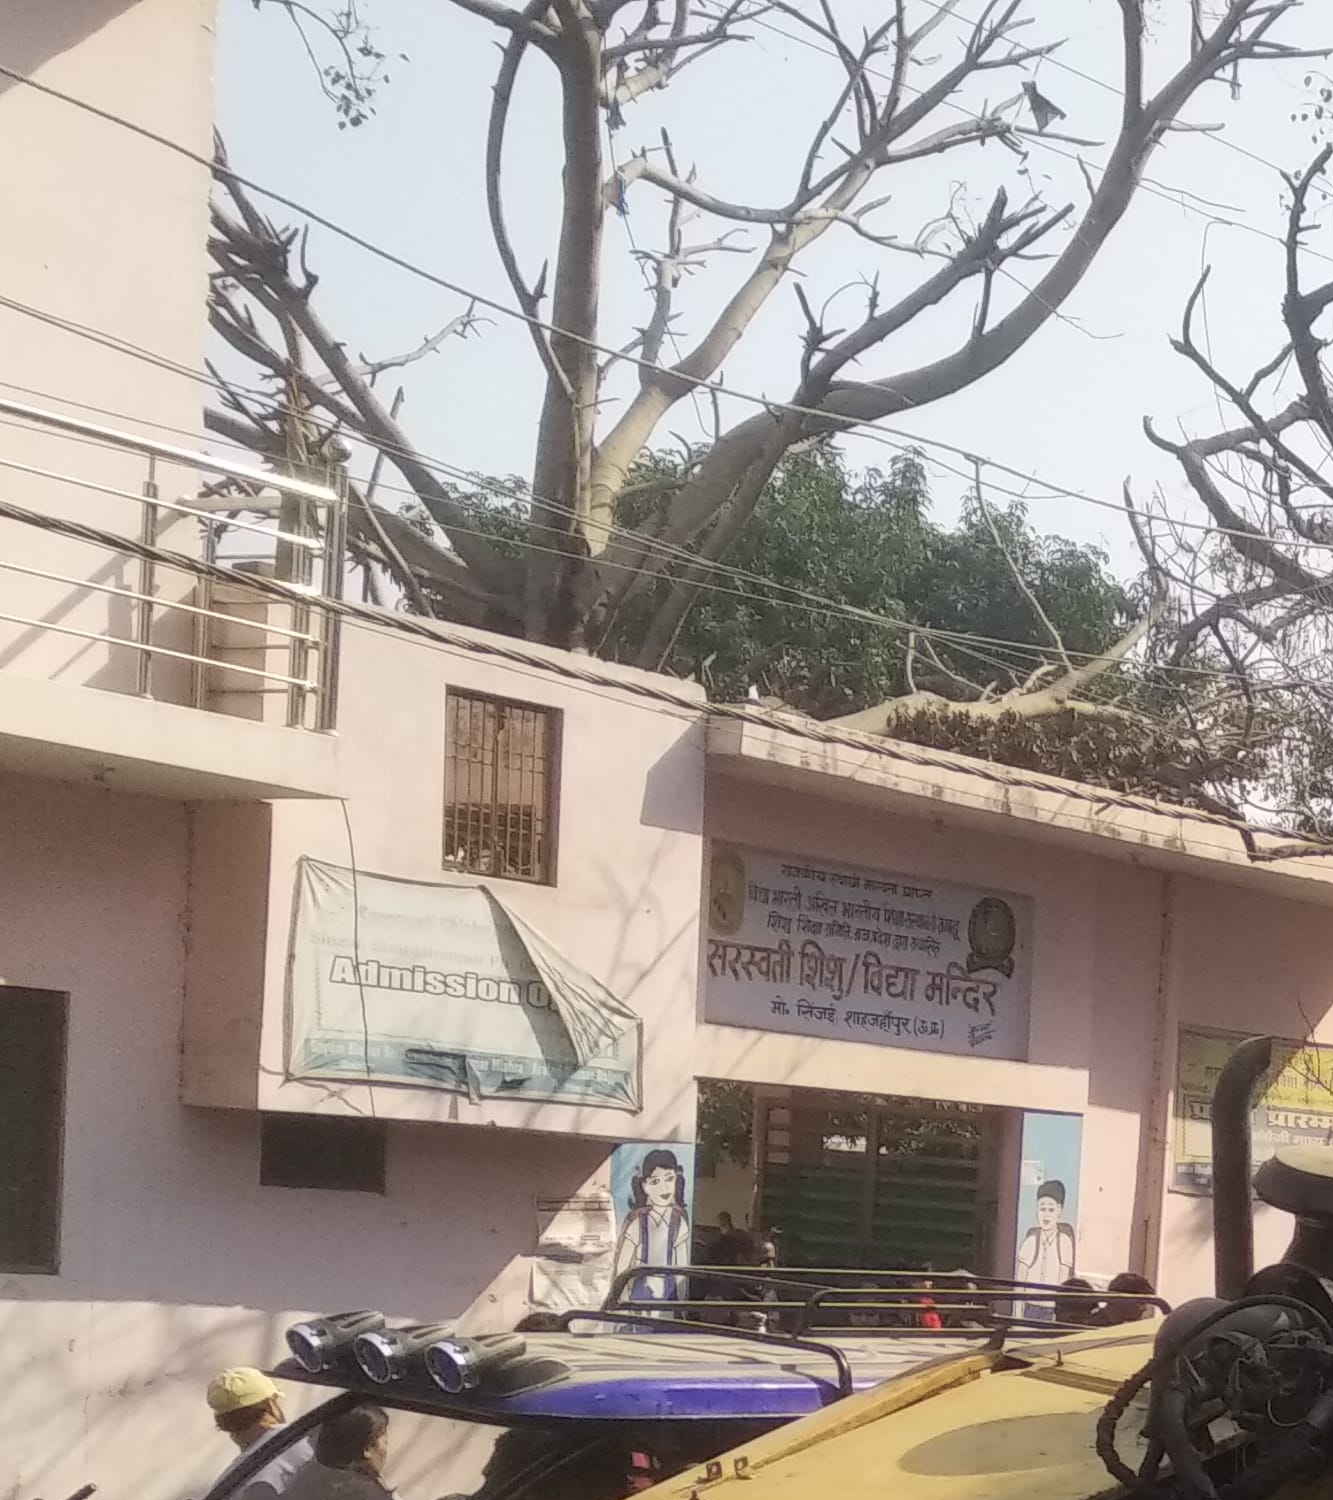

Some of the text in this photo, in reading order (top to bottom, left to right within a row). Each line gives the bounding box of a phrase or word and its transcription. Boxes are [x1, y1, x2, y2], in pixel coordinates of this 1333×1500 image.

[328, 954, 522, 1007] Admission
[706, 936, 794, 984] सरस्वती
[925, 961, 999, 1016] मन्दिर
